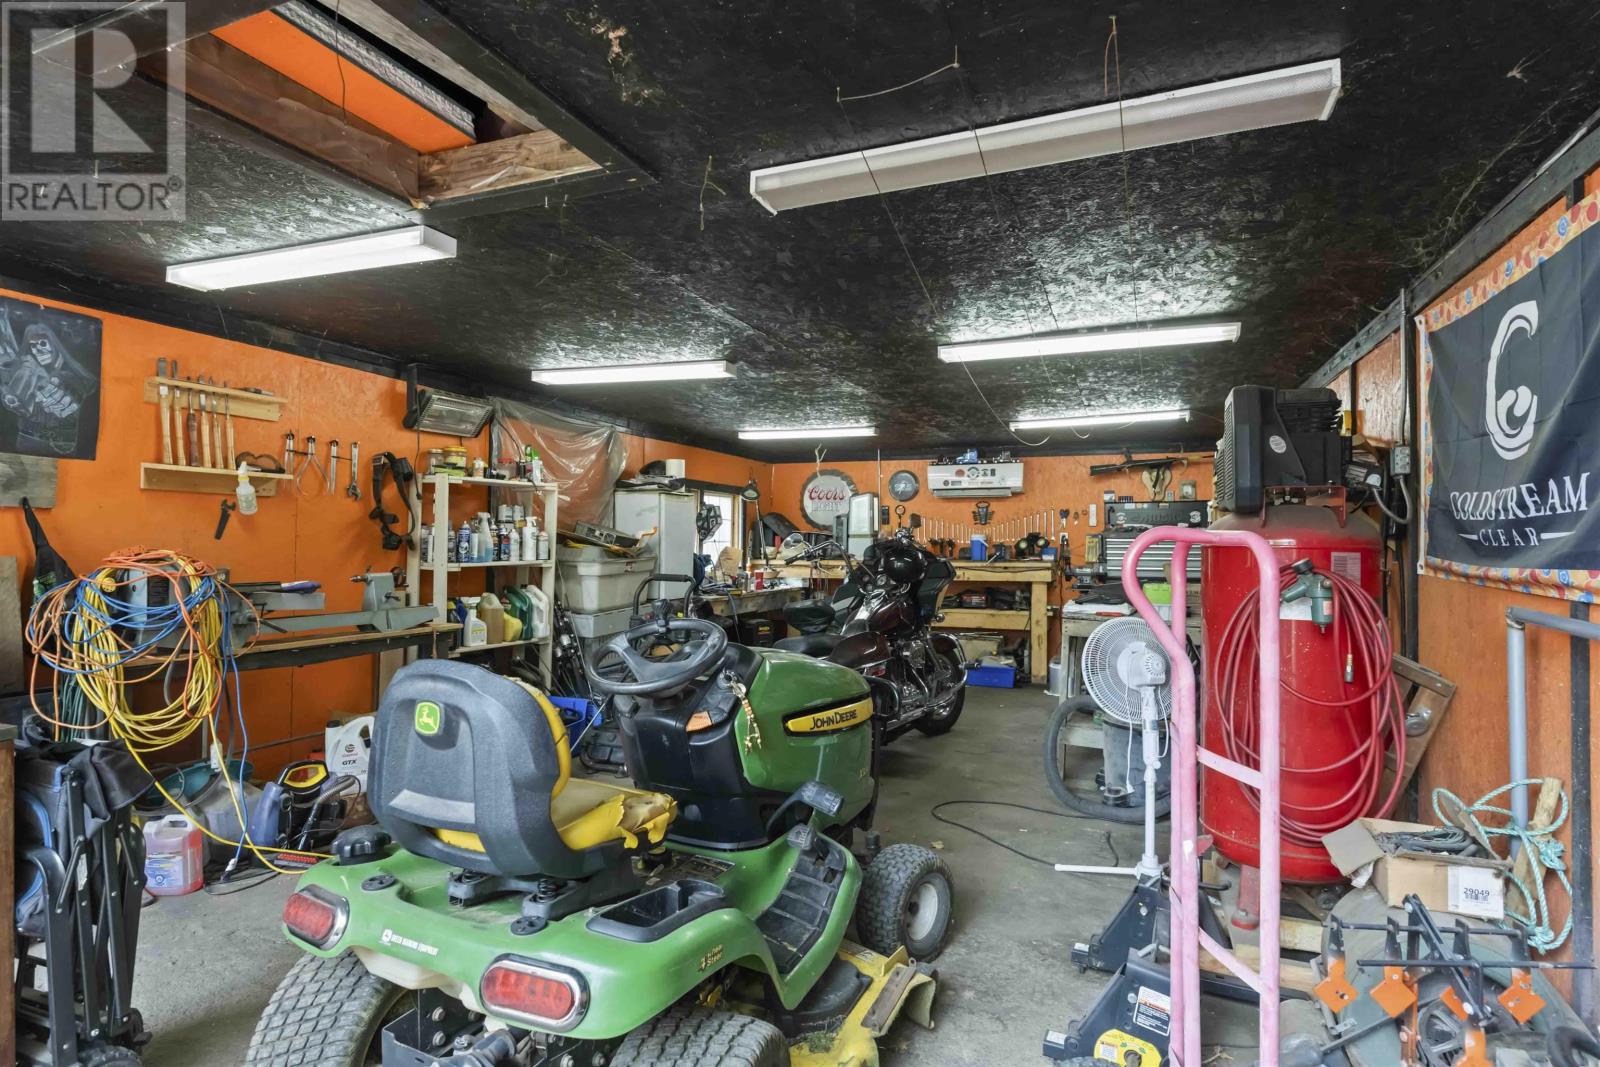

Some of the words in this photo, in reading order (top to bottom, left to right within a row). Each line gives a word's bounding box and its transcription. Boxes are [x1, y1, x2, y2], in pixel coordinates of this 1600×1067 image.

[808, 486, 846, 501] Coors
[1450, 472, 1590, 520] COLDSTREAM
[1479, 527, 1539, 547] CLEAR
[810, 715, 835, 730] JOHN
[834, 709, 857, 724] DEERE
[1463, 887, 1490, 897] 29049
